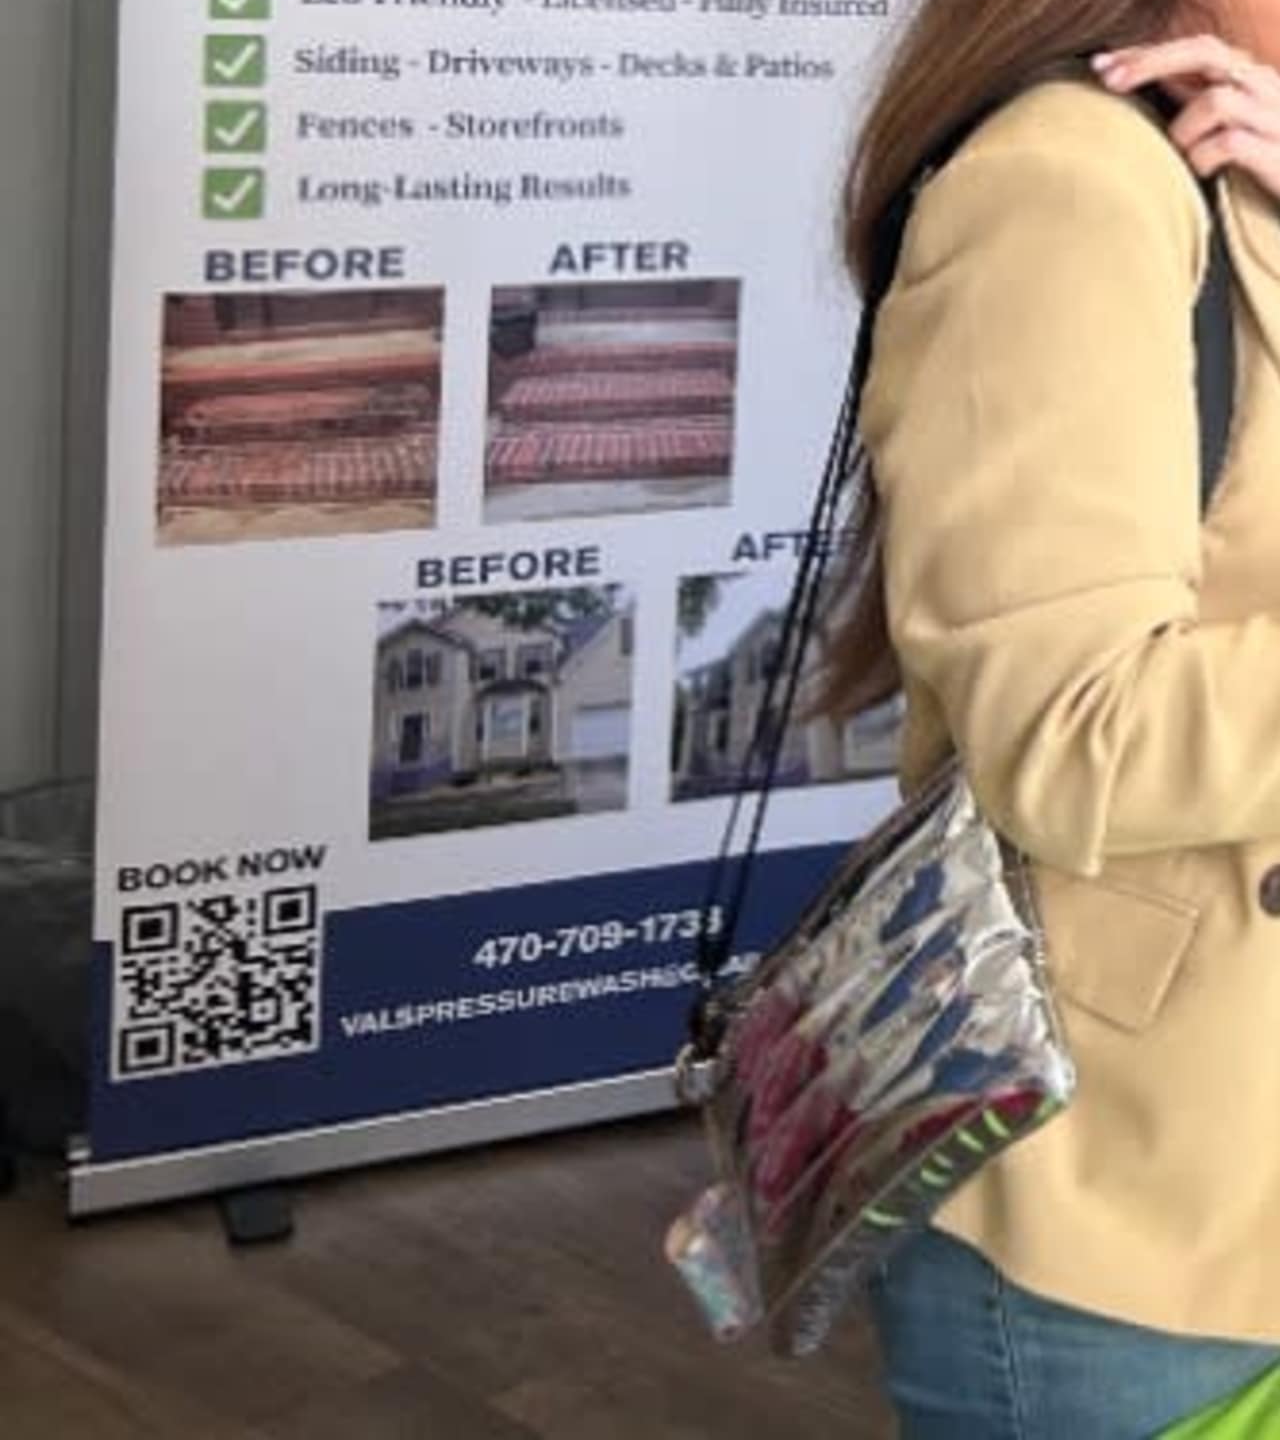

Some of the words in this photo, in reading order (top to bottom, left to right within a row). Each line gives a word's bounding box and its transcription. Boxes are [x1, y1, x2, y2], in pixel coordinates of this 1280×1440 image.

[293, 45, 400, 81] Siding
[428, 47, 595, 84] Driveways
[619, 50, 707, 78] Decks
[715, 51, 737, 78] &
[745, 49, 835, 79] Patios
[297, 111, 414, 139] Fences
[446, 108, 625, 139] Storefronts
[297, 172, 512, 206] Long-Lasting
[520, 171, 633, 201] Results
[204, 247, 407, 282] BEFORE
[550, 240, 692, 275] AFTER
[416, 545, 600, 589] BEFORE
[118, 857, 229, 892] BOOK
[236, 843, 327, 877] NOW
